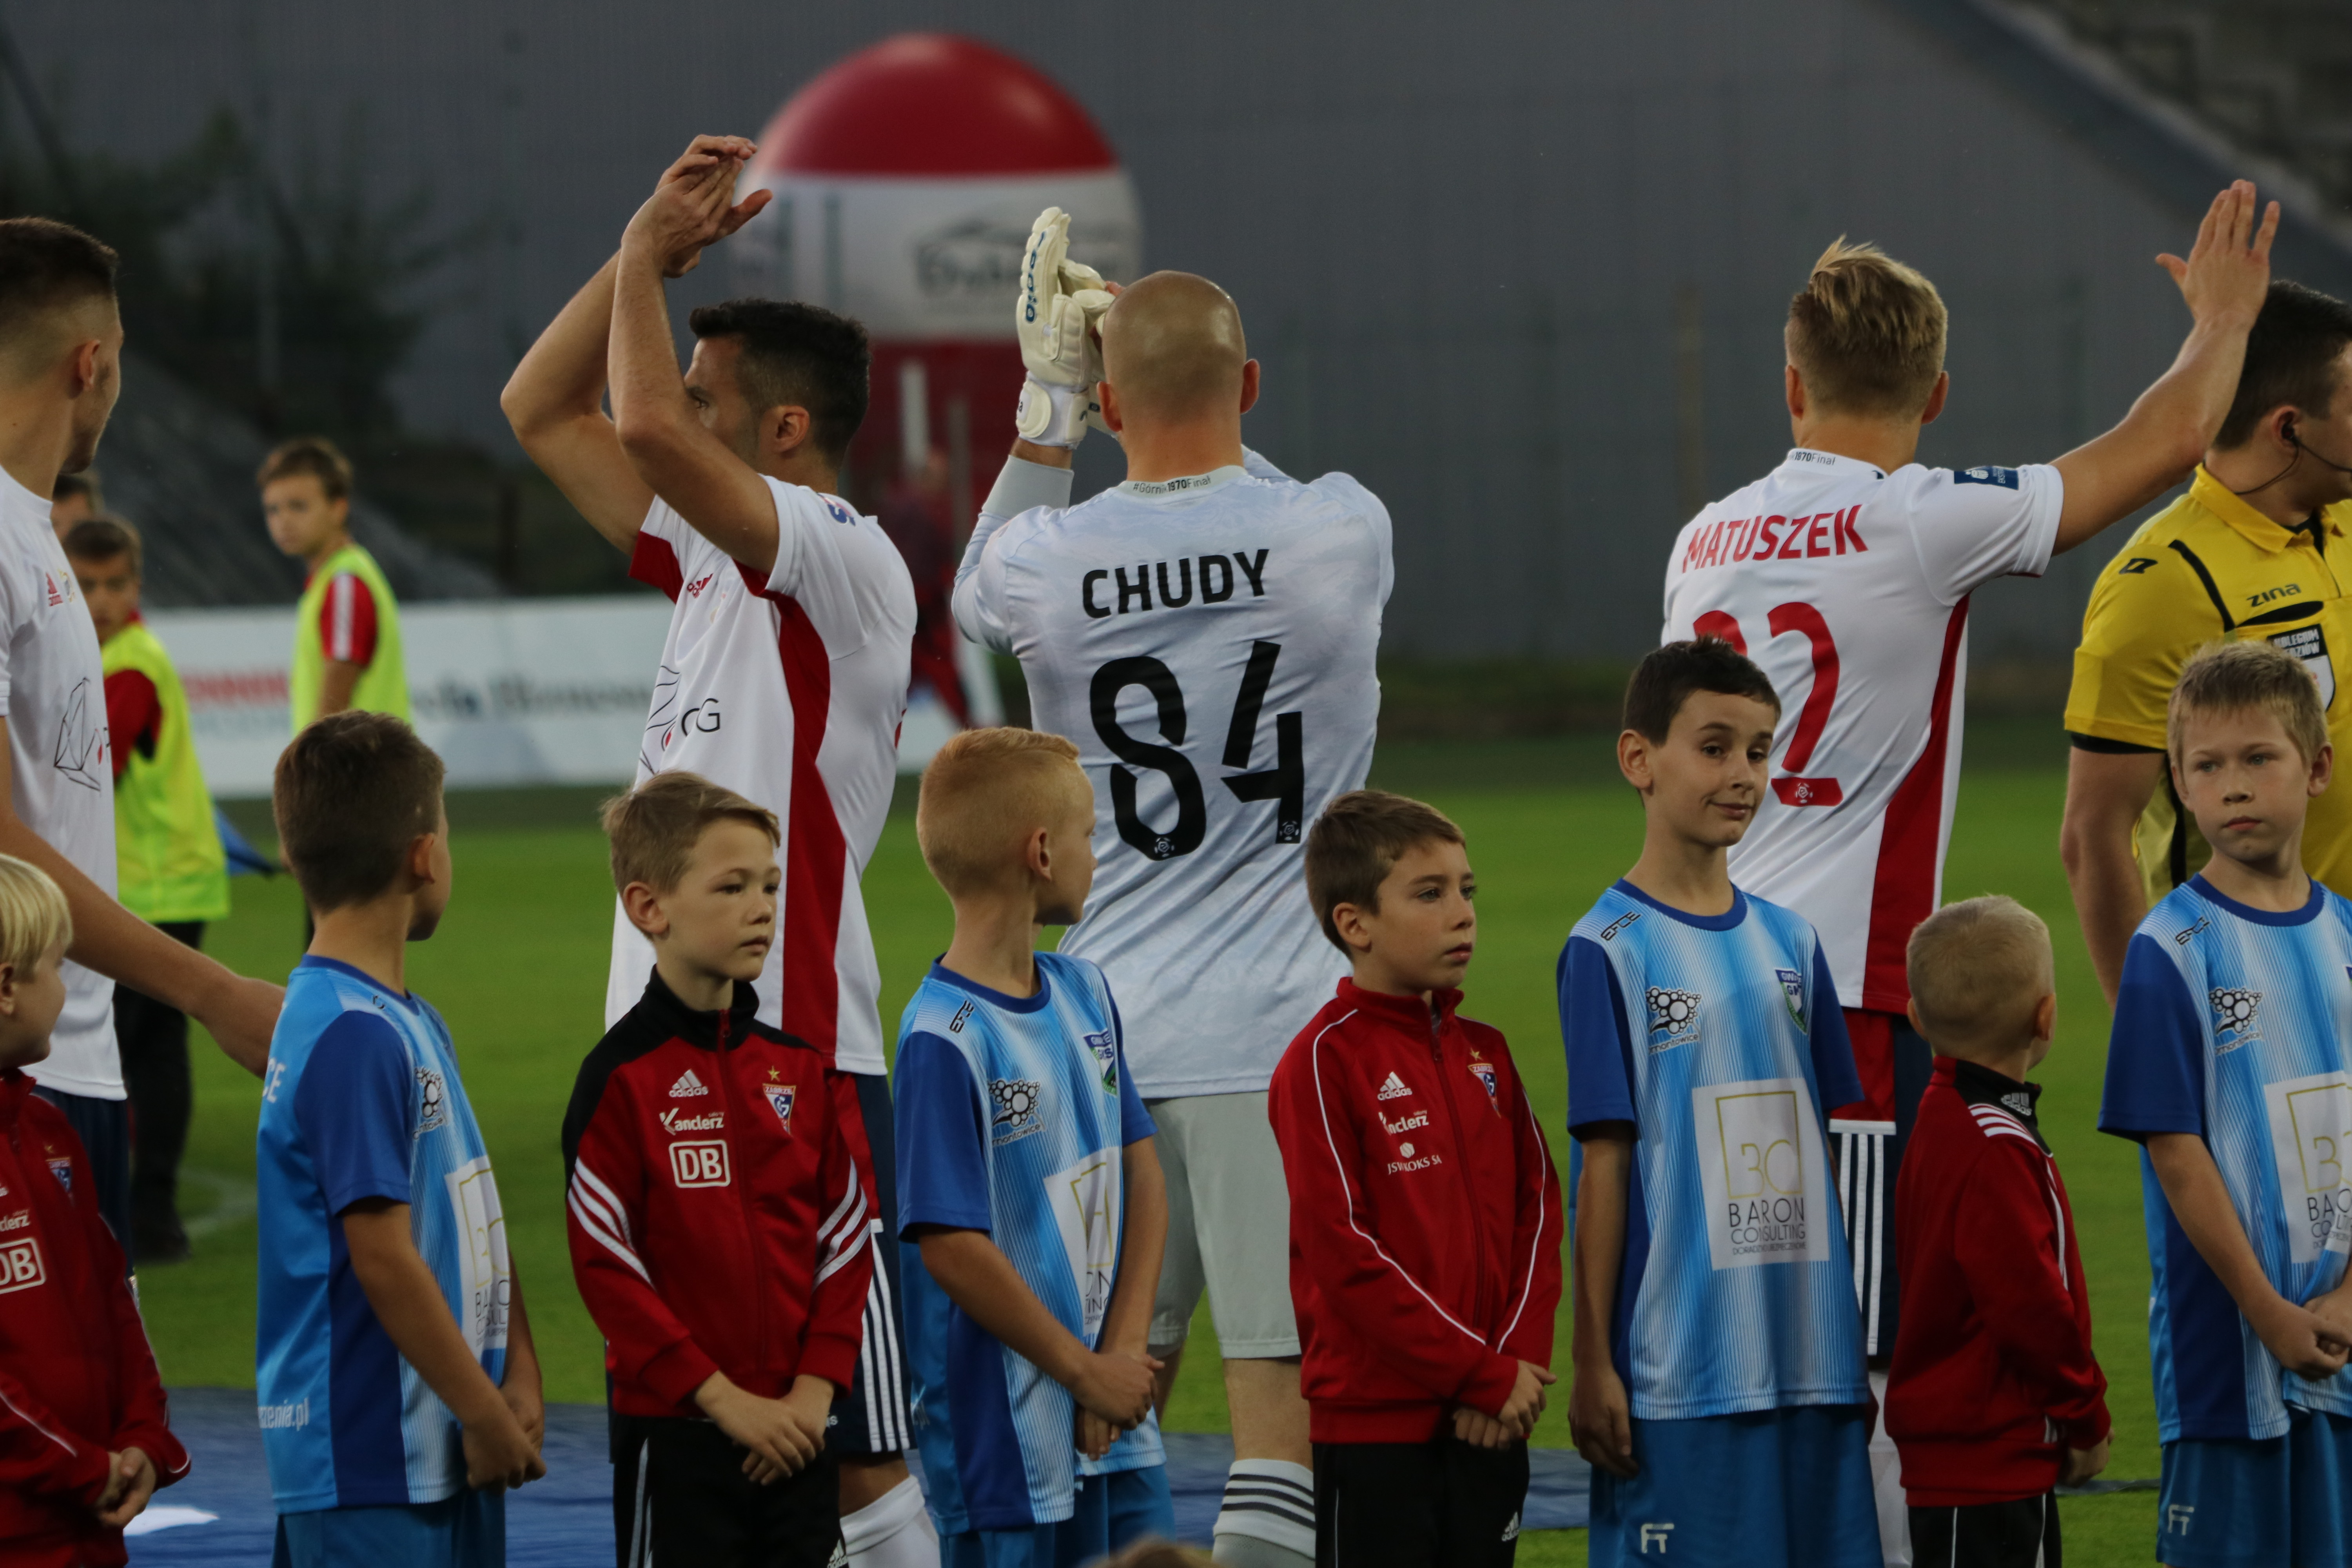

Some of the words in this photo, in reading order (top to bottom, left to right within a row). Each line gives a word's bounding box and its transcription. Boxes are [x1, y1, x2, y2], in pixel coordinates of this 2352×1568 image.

[1682, 505, 1868, 573] MATUSZEK
[1083, 549, 1269, 618] CHUDY
[2247, 583, 2301, 607] zina
[1693, 602, 1843, 806] 2
[1090, 641, 1304, 861] 84
[669, 1085, 709, 1098] adidas
[1377, 1087, 1413, 1101] adidas
[678, 1148, 722, 1180] DB
[1431, 1154, 1442, 1165] SA
[1729, 1198, 1804, 1228] BARON
[1731, 1223, 1806, 1244] CONSULTING
